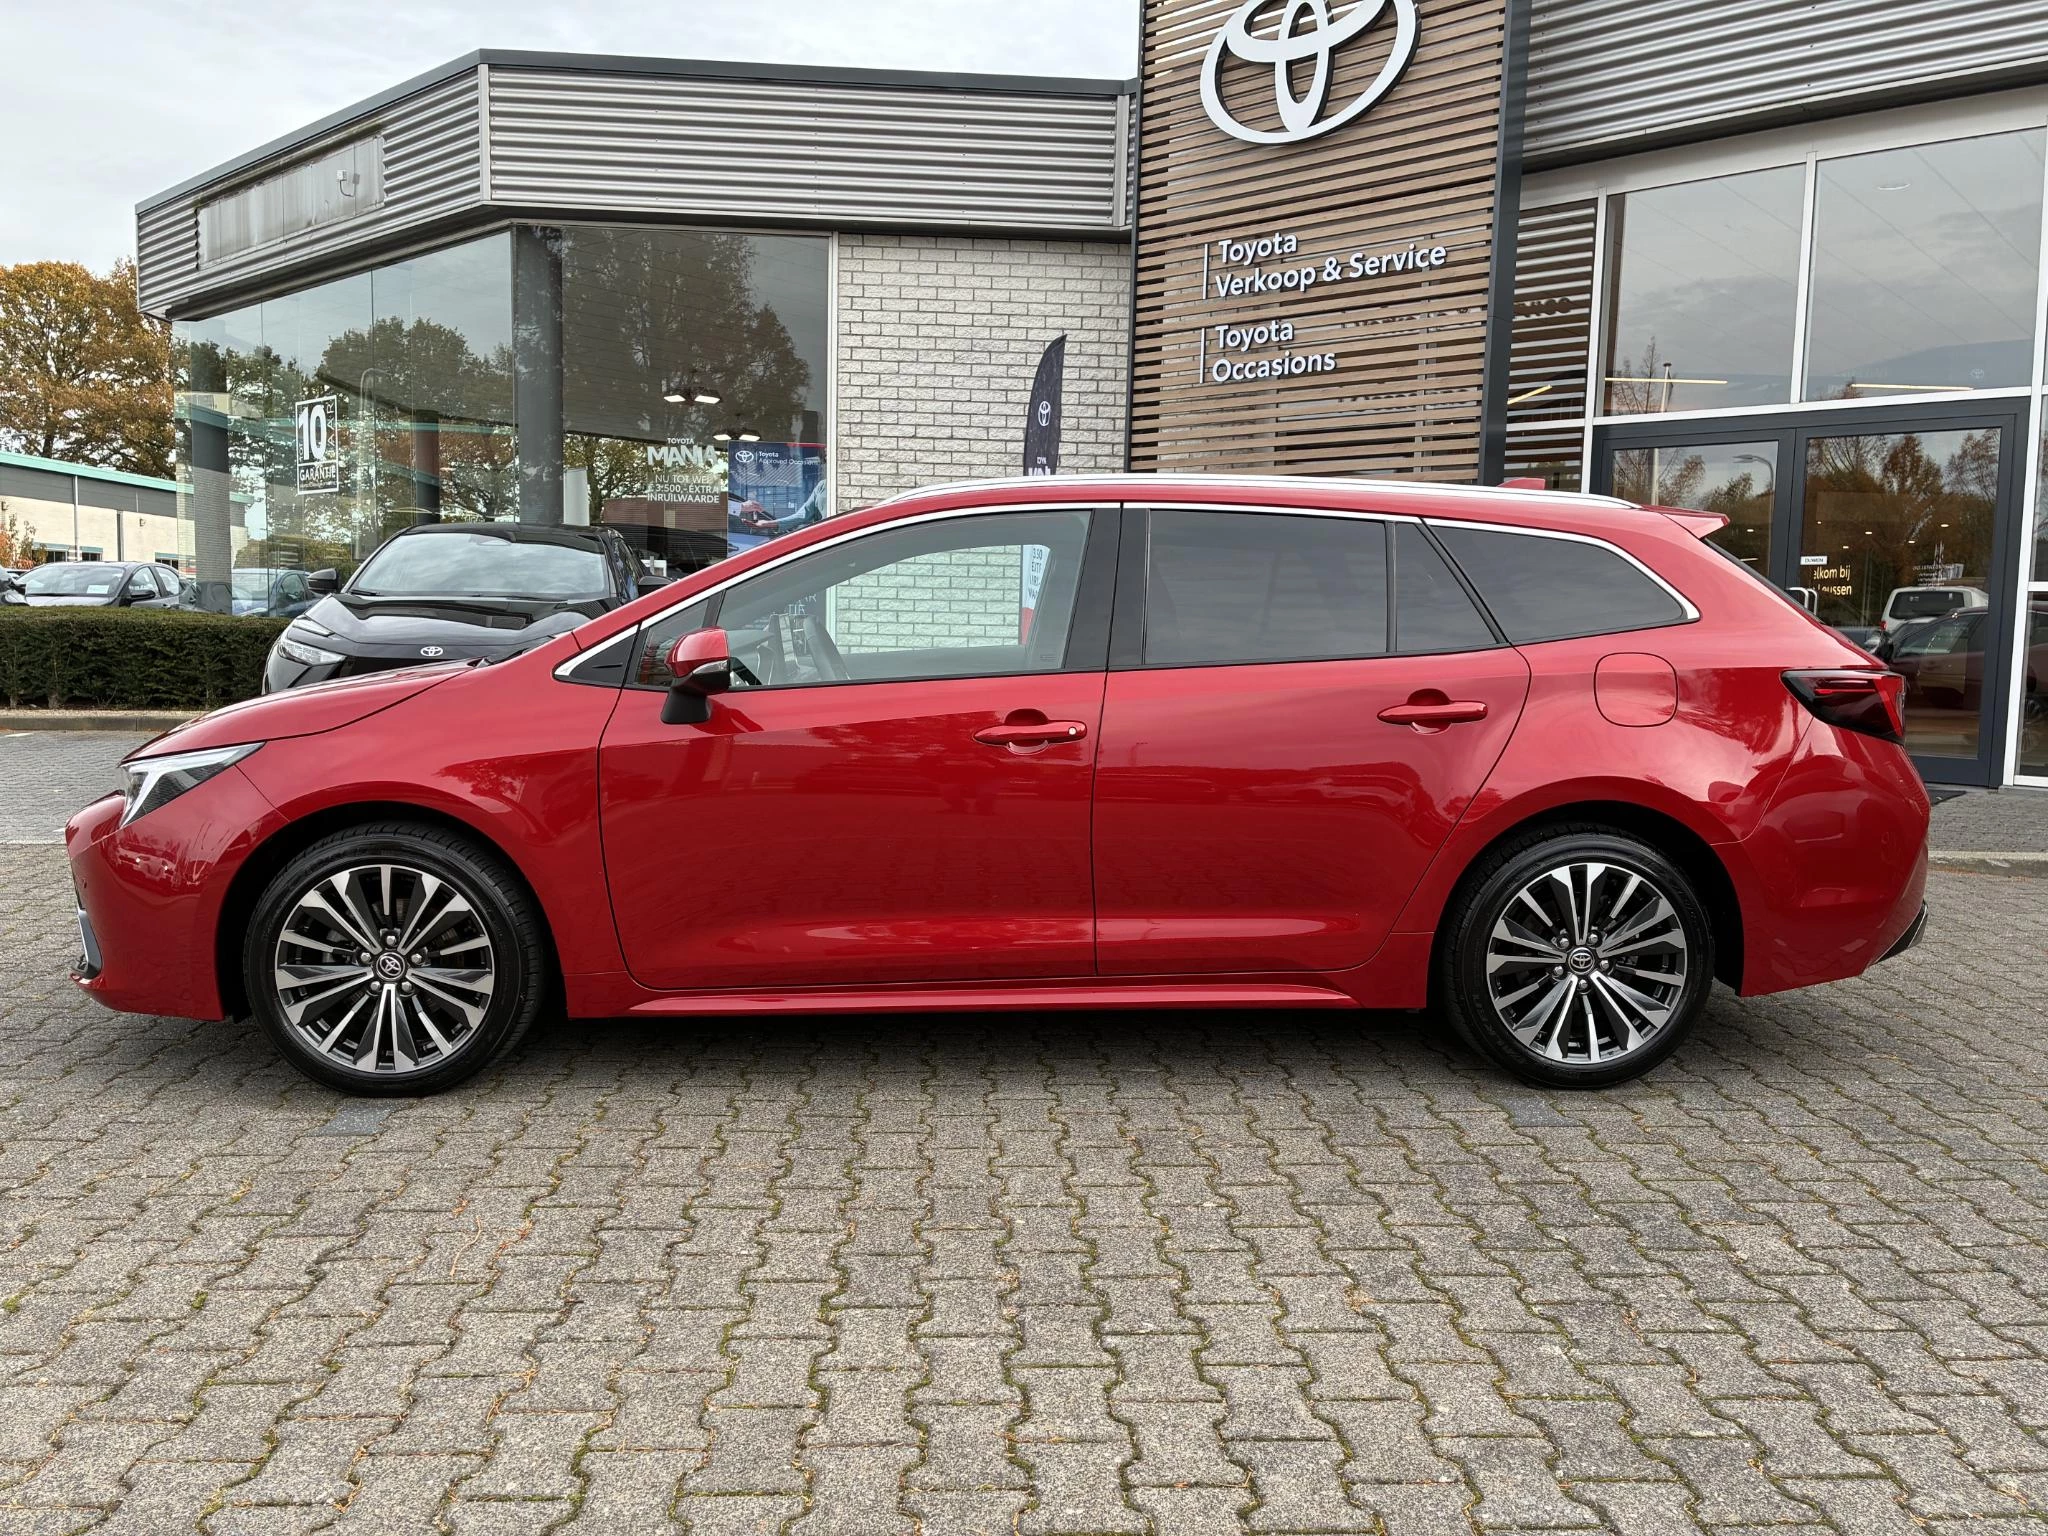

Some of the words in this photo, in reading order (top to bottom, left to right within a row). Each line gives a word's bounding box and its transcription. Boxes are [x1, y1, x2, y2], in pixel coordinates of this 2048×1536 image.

[1218, 232, 1298, 265] Toyota
[1215, 266, 1317, 297] Verkoop
[1322, 257, 1342, 282] &
[1349, 243, 1447, 278] Service
[1215, 320, 1294, 351] Toyota
[1212, 351, 1336, 382] Occasions
[299, 405, 327, 461] 10
[647, 445, 718, 467] MANIA
[300, 465, 336, 481] GARANTIE
[655, 475, 669, 483] NU
[673, 475, 689, 484] TOT
[647, 493, 720, 504] INRUILWAARDE
[689, 485, 719, 494] EXTRA
[1840, 565, 1850, 581] bij
